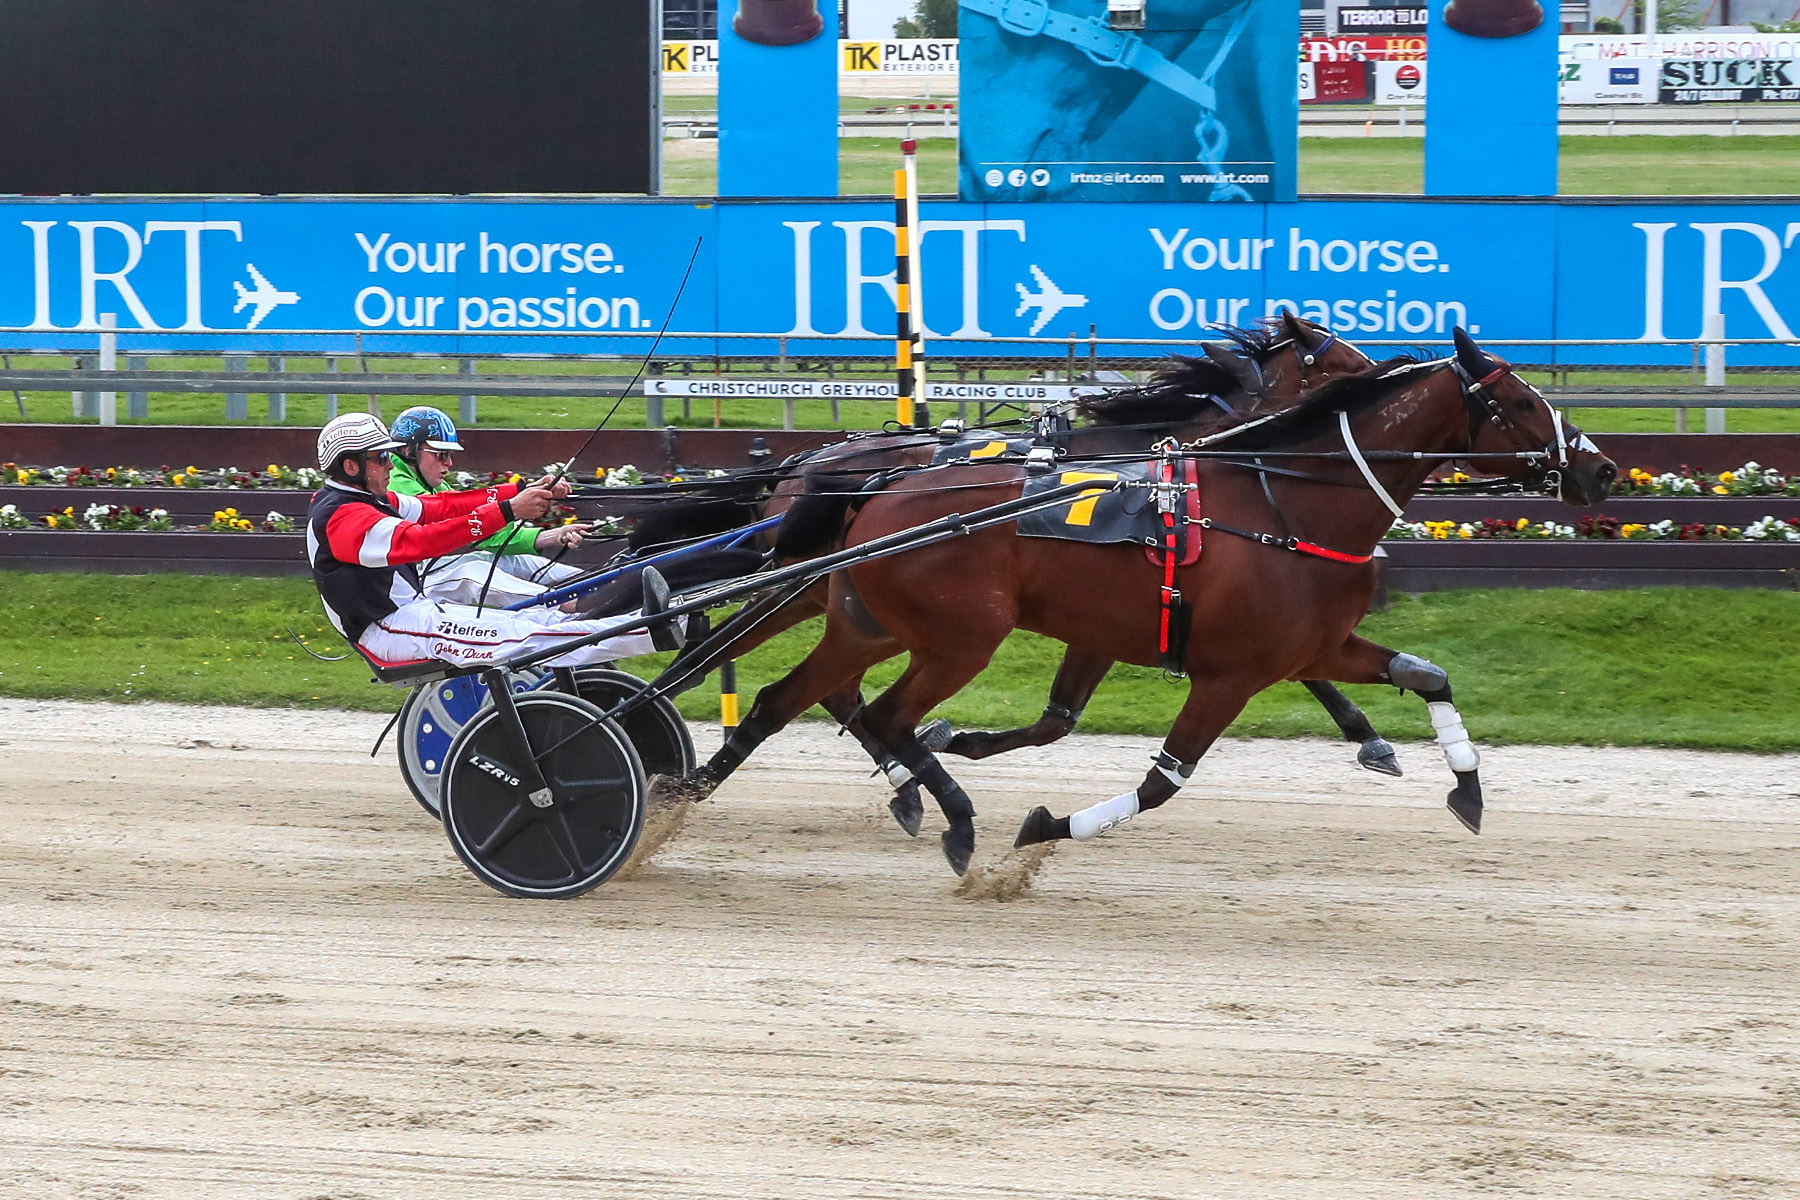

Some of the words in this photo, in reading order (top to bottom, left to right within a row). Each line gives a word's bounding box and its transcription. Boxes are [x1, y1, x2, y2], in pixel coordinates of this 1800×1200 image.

[1341, 10, 1395, 26] TERROR
[883, 63, 944, 72] EXTERIOR
[1070, 172, 1165, 185] irtnz@irt.com
[1180, 173, 1269, 184] www.irt.com
[354, 233, 466, 273] Your
[479, 231, 624, 274] horse.
[1149, 228, 1275, 271] Your
[1288, 227, 1450, 273] horse.
[21, 220, 243, 331] IRT
[1631, 222, 1800, 342] IR
[354, 285, 445, 328] Our
[458, 287, 652, 332] passion.
[1149, 287, 1249, 332] Our
[688, 382, 813, 395] CHRISTCHURCH
[933, 386, 997, 398] RACING
[1004, 387, 1047, 398] CLUB
[329, 428, 359, 441] telfers
[453, 623, 498, 638] telfers
[434, 642, 460, 656] John
[462, 647, 494, 659] Dunn
[469, 755, 506, 779] LZR
